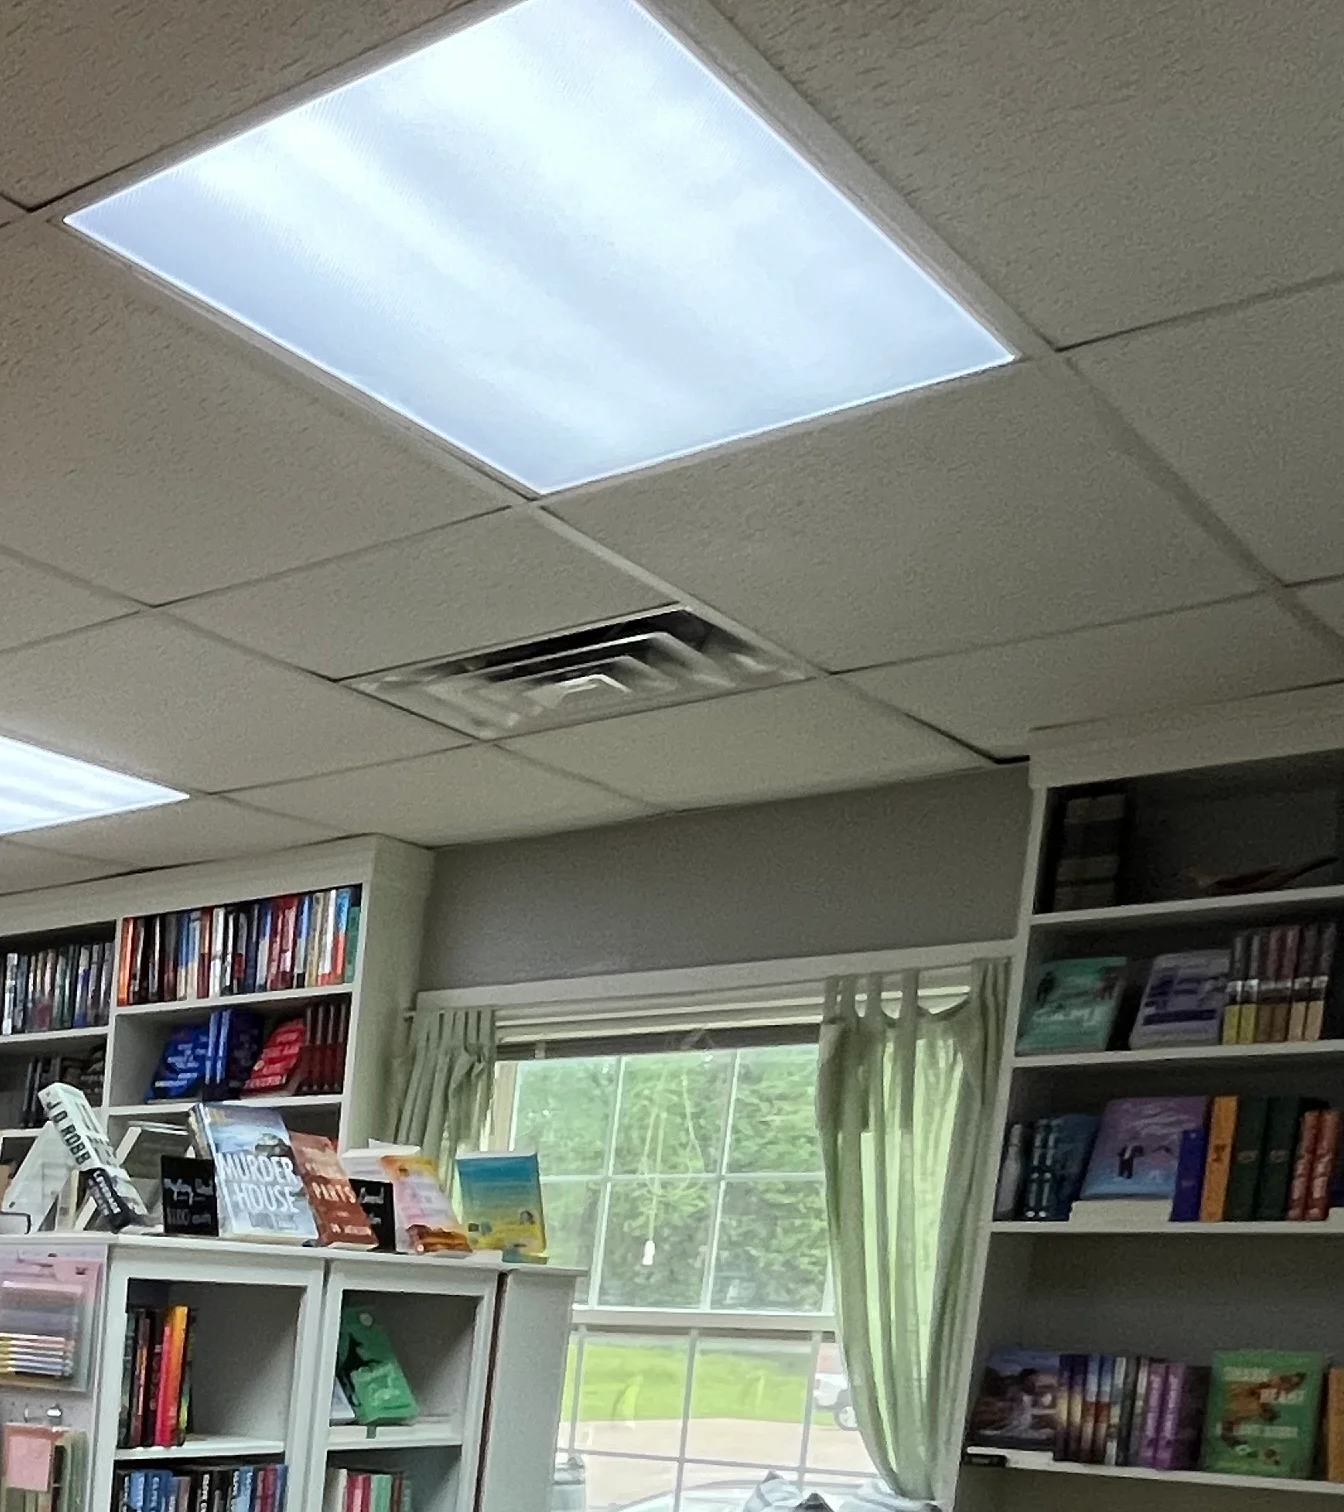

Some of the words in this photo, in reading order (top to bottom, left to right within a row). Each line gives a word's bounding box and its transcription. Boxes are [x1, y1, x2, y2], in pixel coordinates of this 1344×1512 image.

[60, 1123, 92, 1166] ROBB
[218, 1153, 298, 1186] MURDER
[234, 1182, 300, 1213] HOUSE
